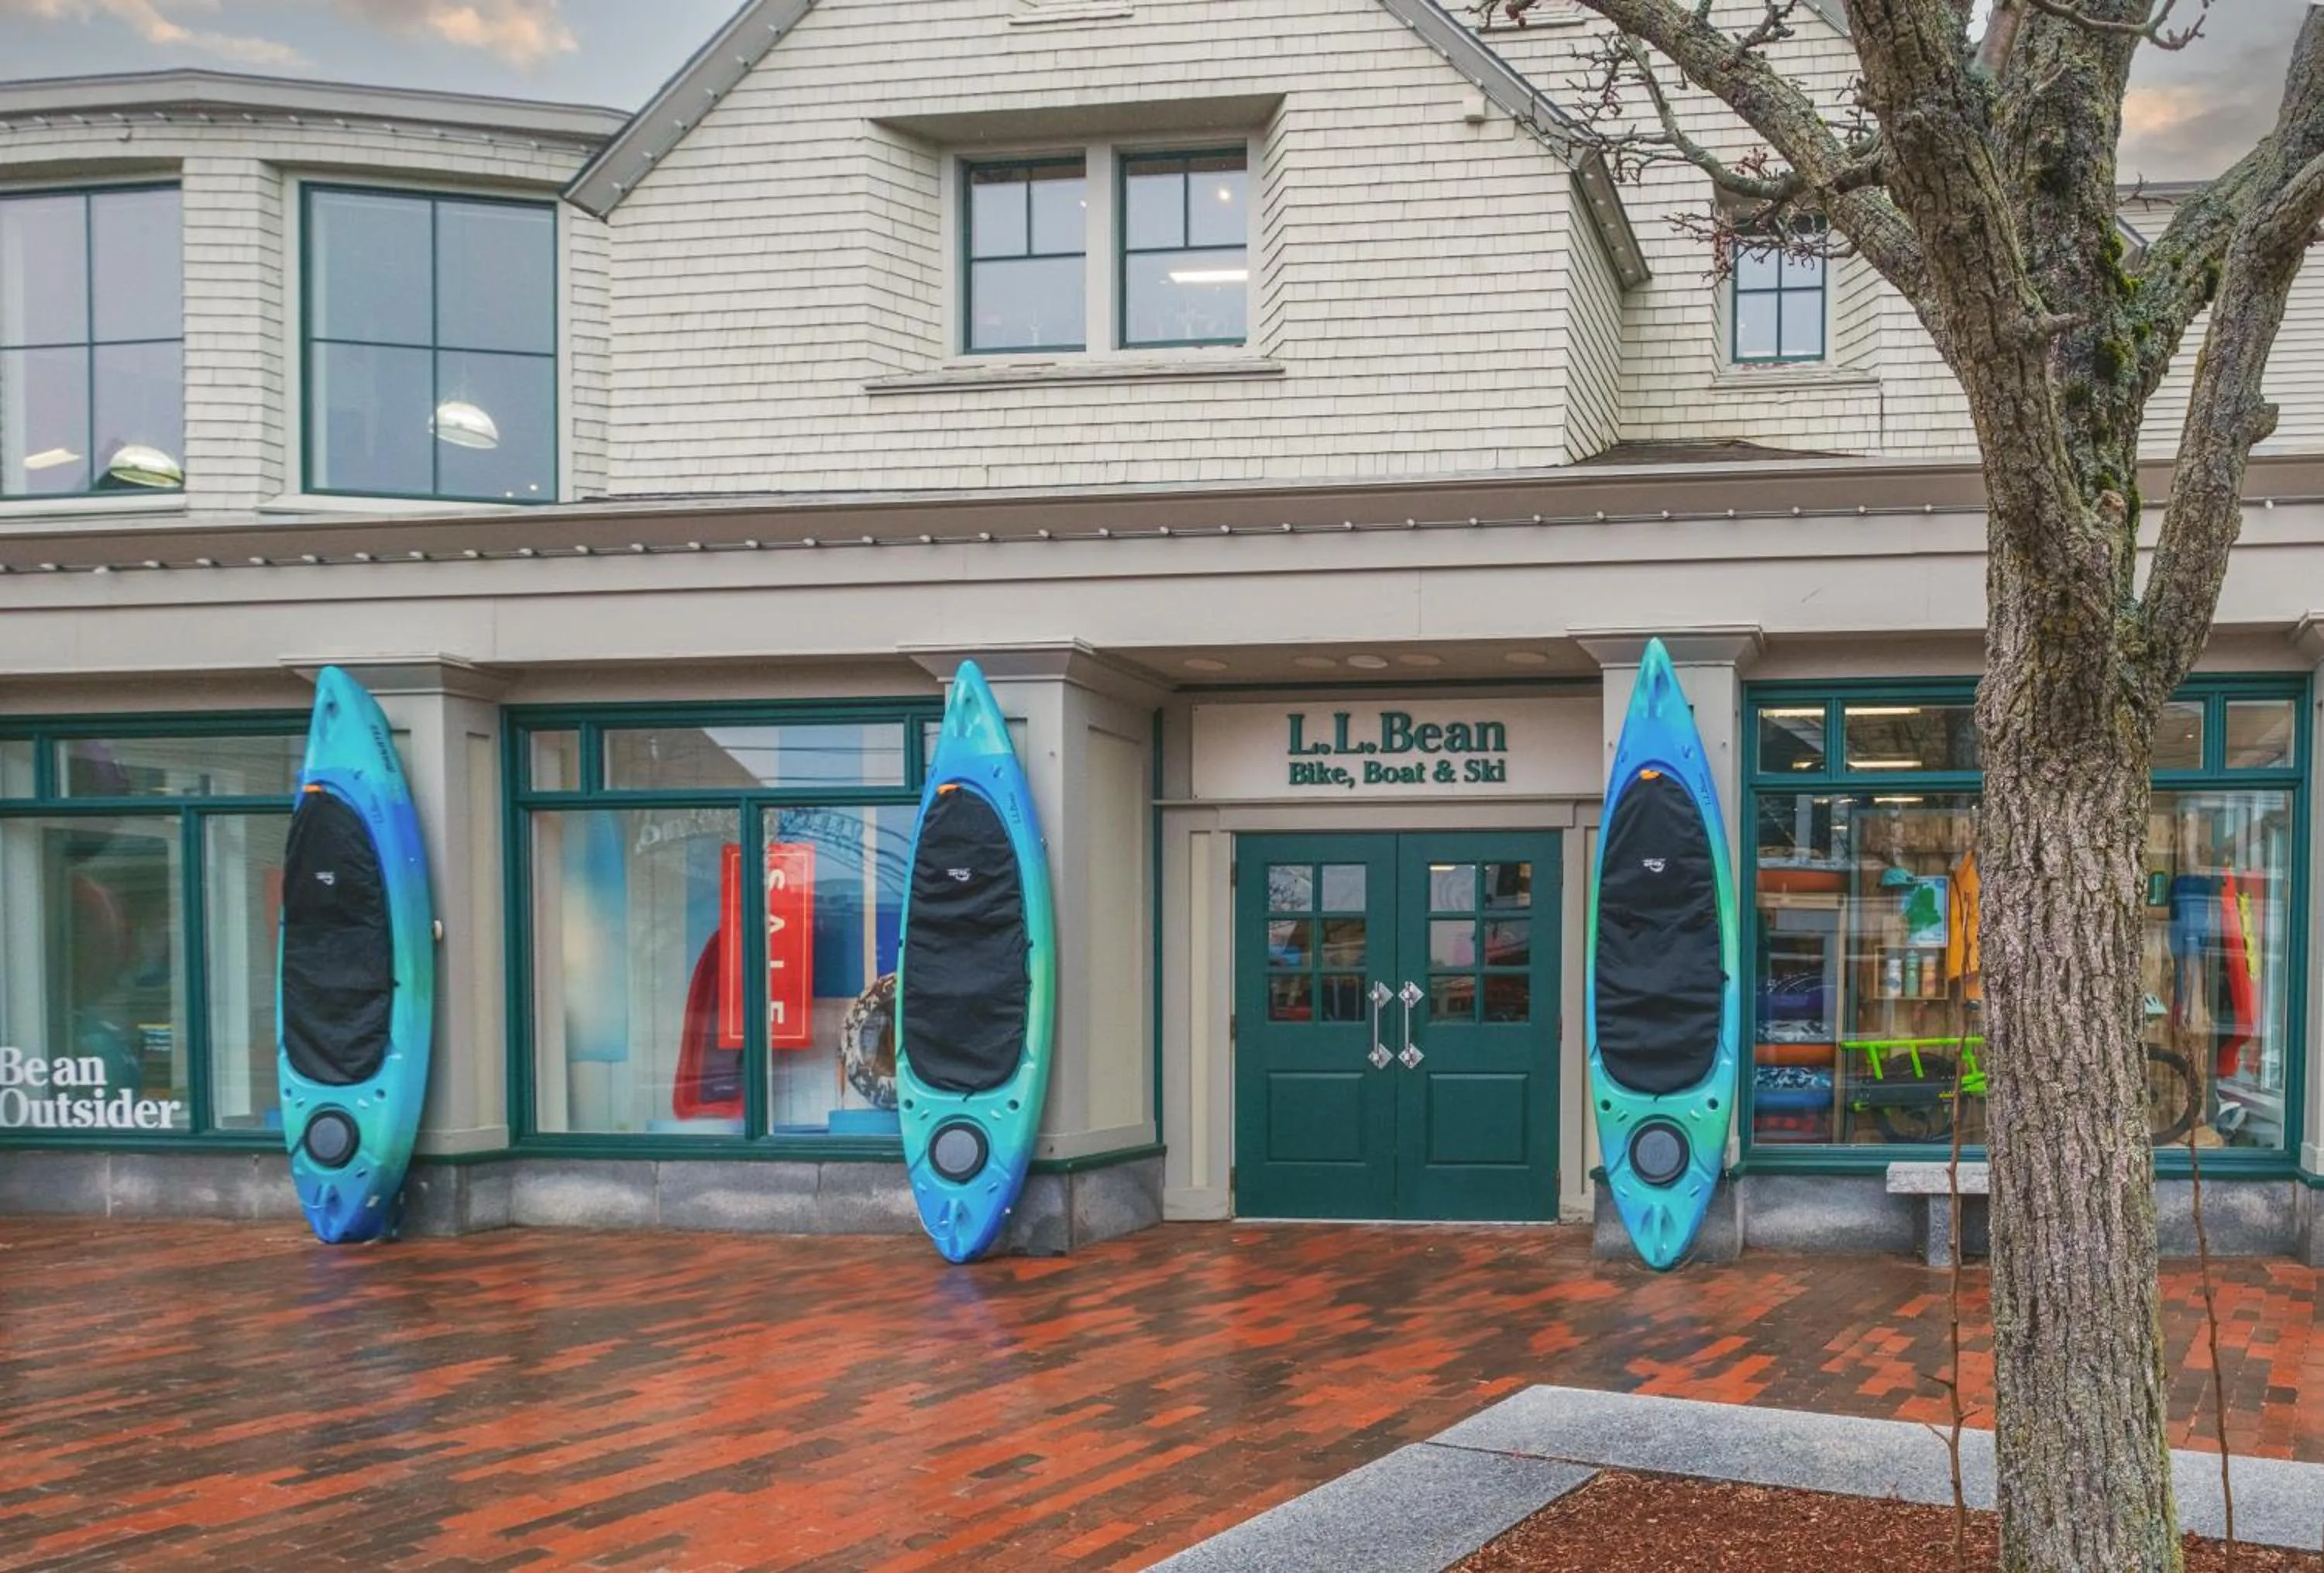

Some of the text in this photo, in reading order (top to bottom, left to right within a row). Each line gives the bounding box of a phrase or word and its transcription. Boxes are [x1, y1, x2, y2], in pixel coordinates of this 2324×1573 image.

[1287, 711, 1508, 756] L.L.Bean
[1289, 758, 1506, 788] Bike, Boat & Ski
[0, 1087, 181, 1129] Outsider
